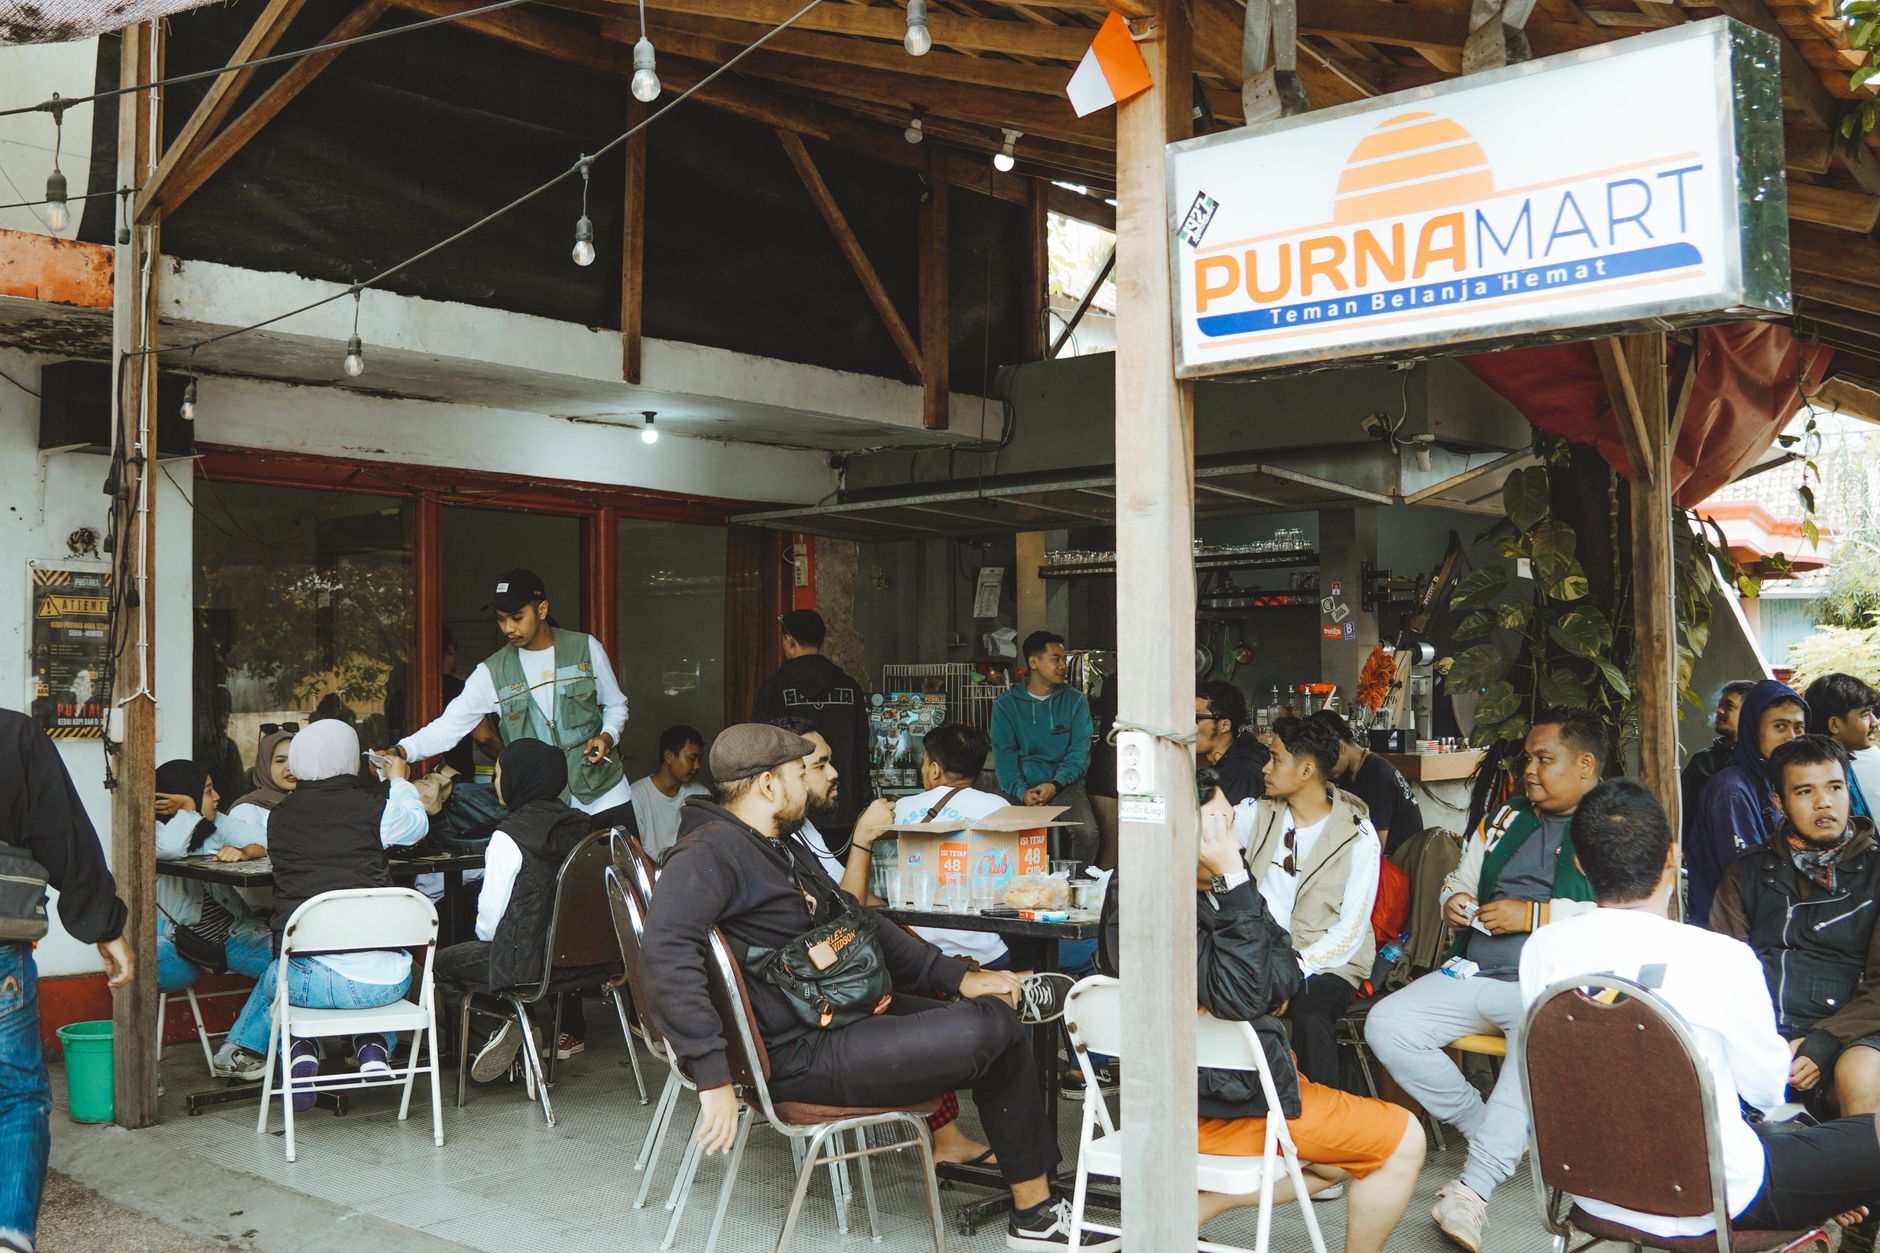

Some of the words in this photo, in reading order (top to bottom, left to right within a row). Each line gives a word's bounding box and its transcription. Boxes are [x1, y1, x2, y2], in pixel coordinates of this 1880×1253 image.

[1270, 299, 1358, 325] Teman
[1371, 279, 1488, 312] Belanja
[1502, 259, 1607, 291] Hemat
[61, 599, 109, 612] ATTENT
[1024, 848, 1041, 864] 48
[944, 859, 961, 871] 48
[978, 854, 1008, 877] Club
